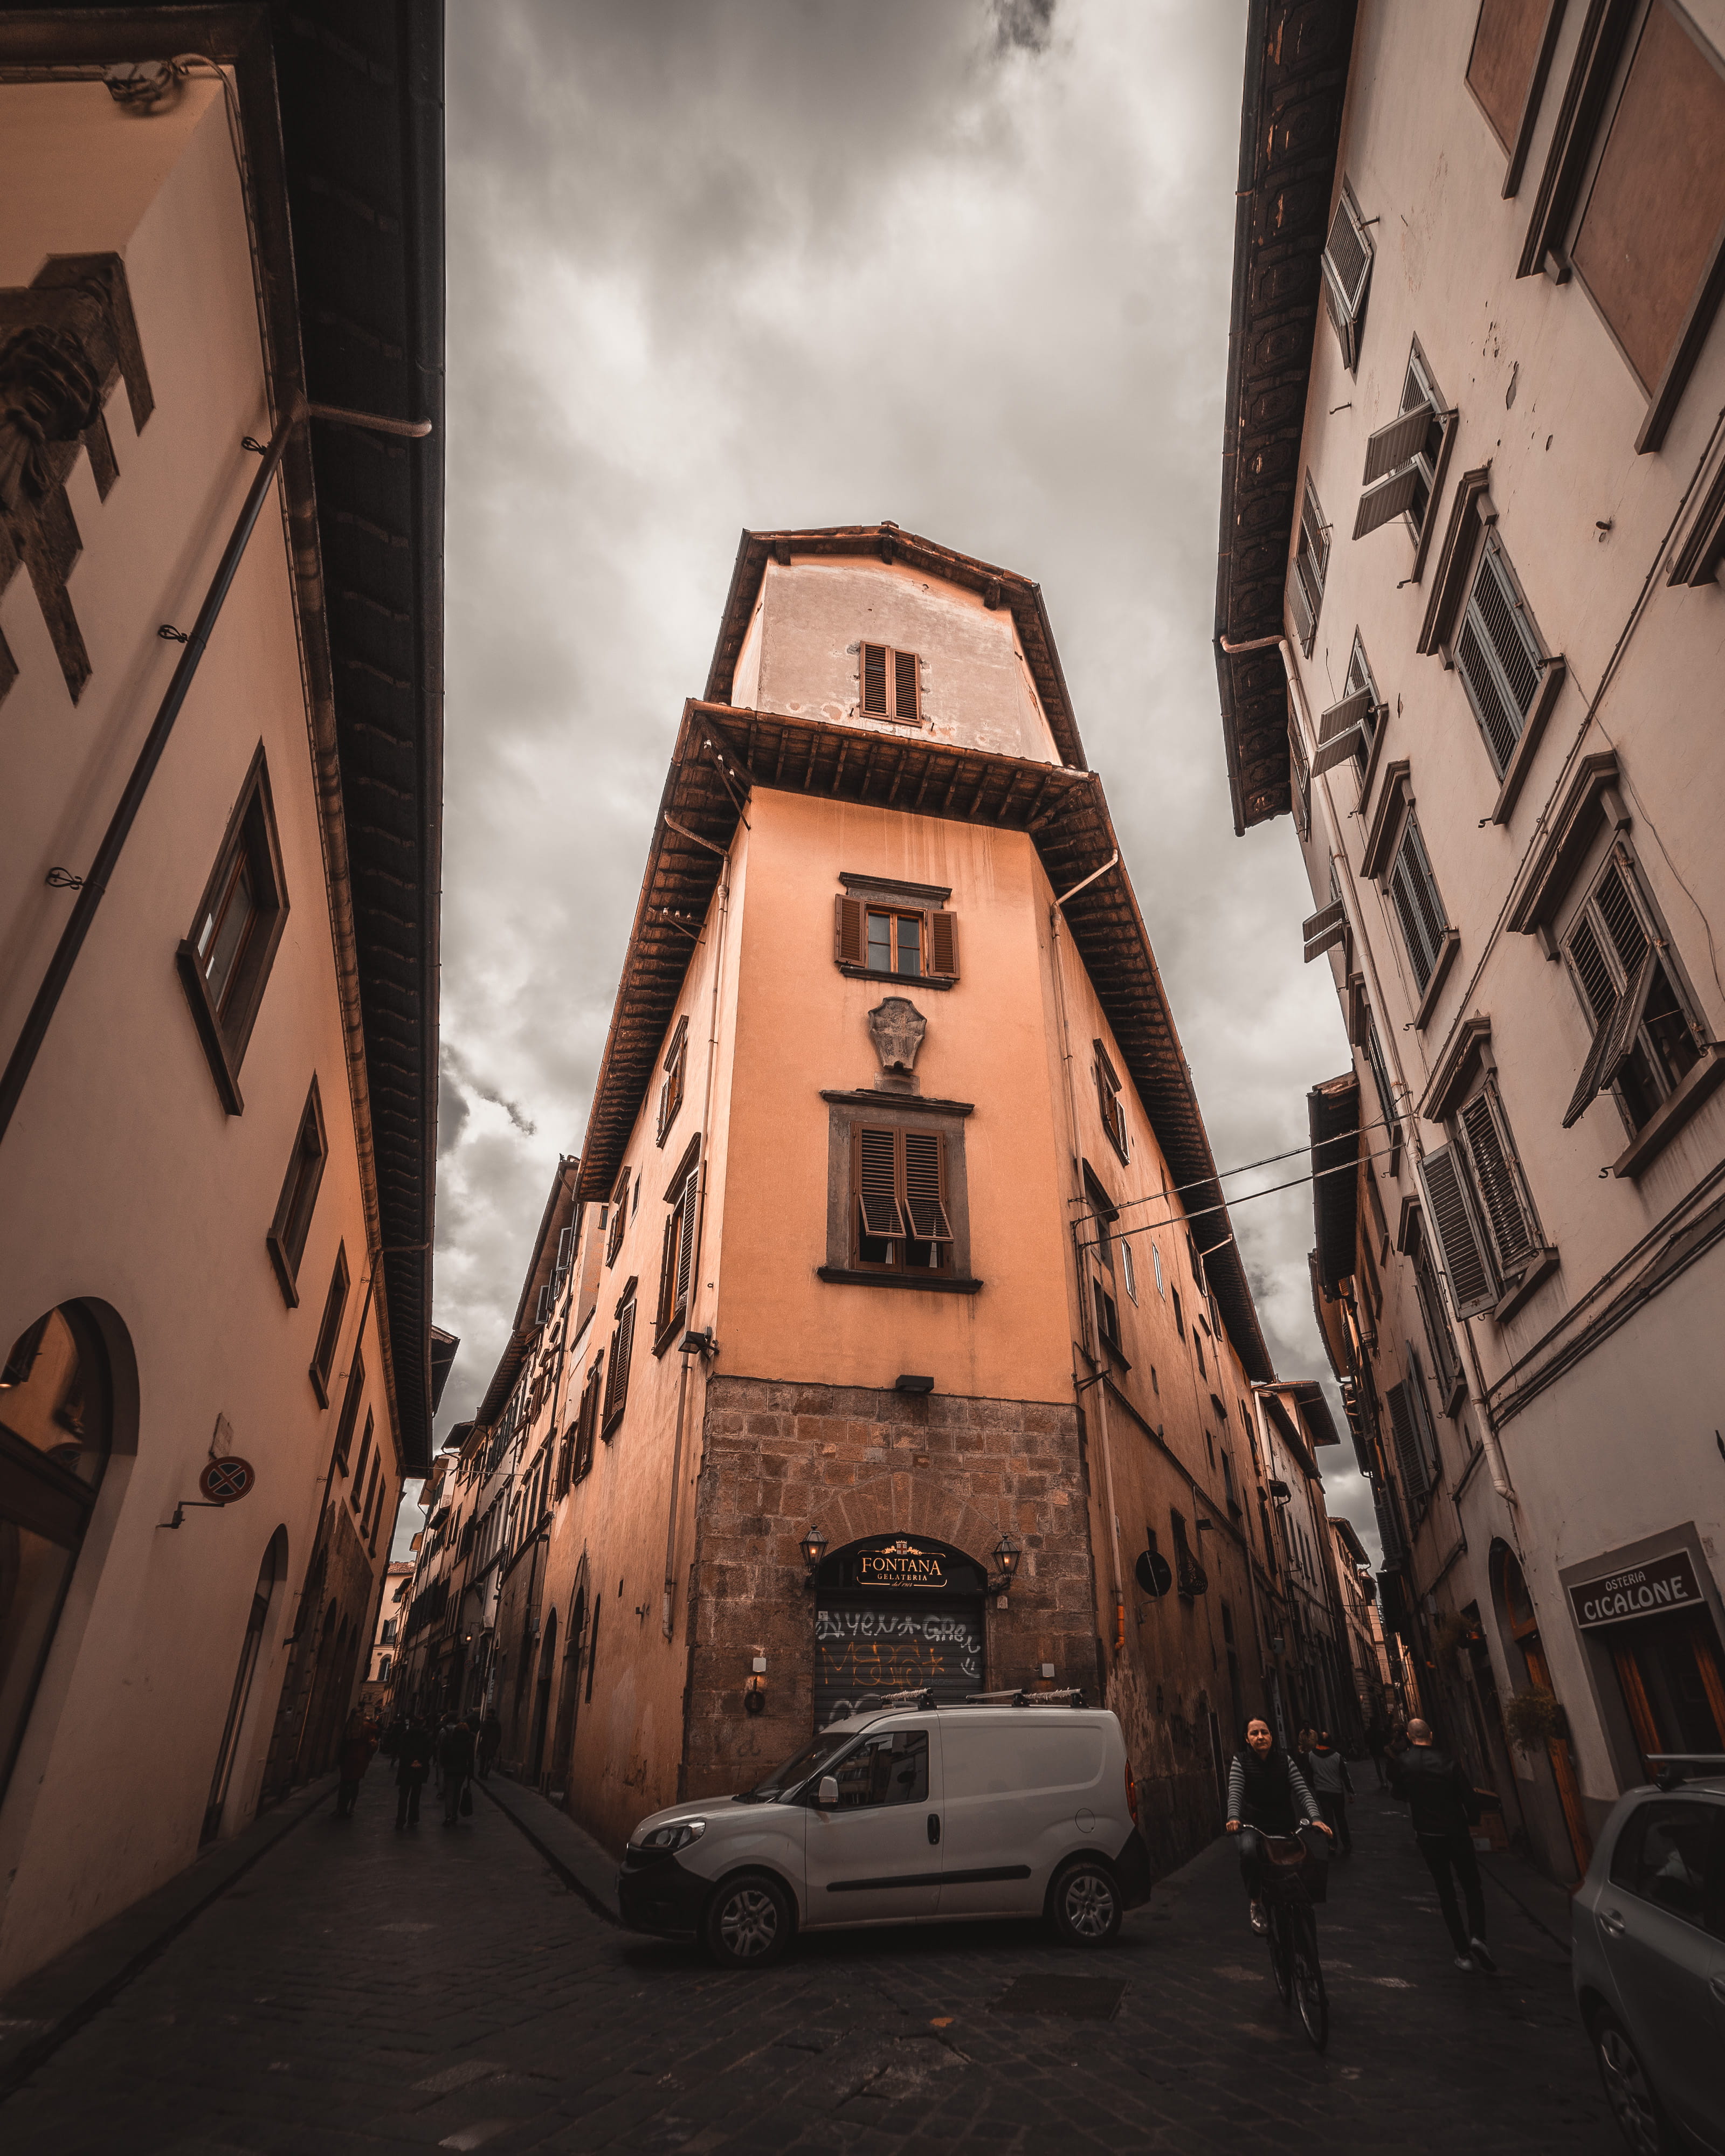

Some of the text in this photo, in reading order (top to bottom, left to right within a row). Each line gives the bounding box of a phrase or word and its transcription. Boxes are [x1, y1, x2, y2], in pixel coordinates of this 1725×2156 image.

[861, 1557, 942, 1575] FONTANA
[1605, 1571, 1646, 1591] OSTERIA
[1584, 1575, 1688, 1620] CICALONE
